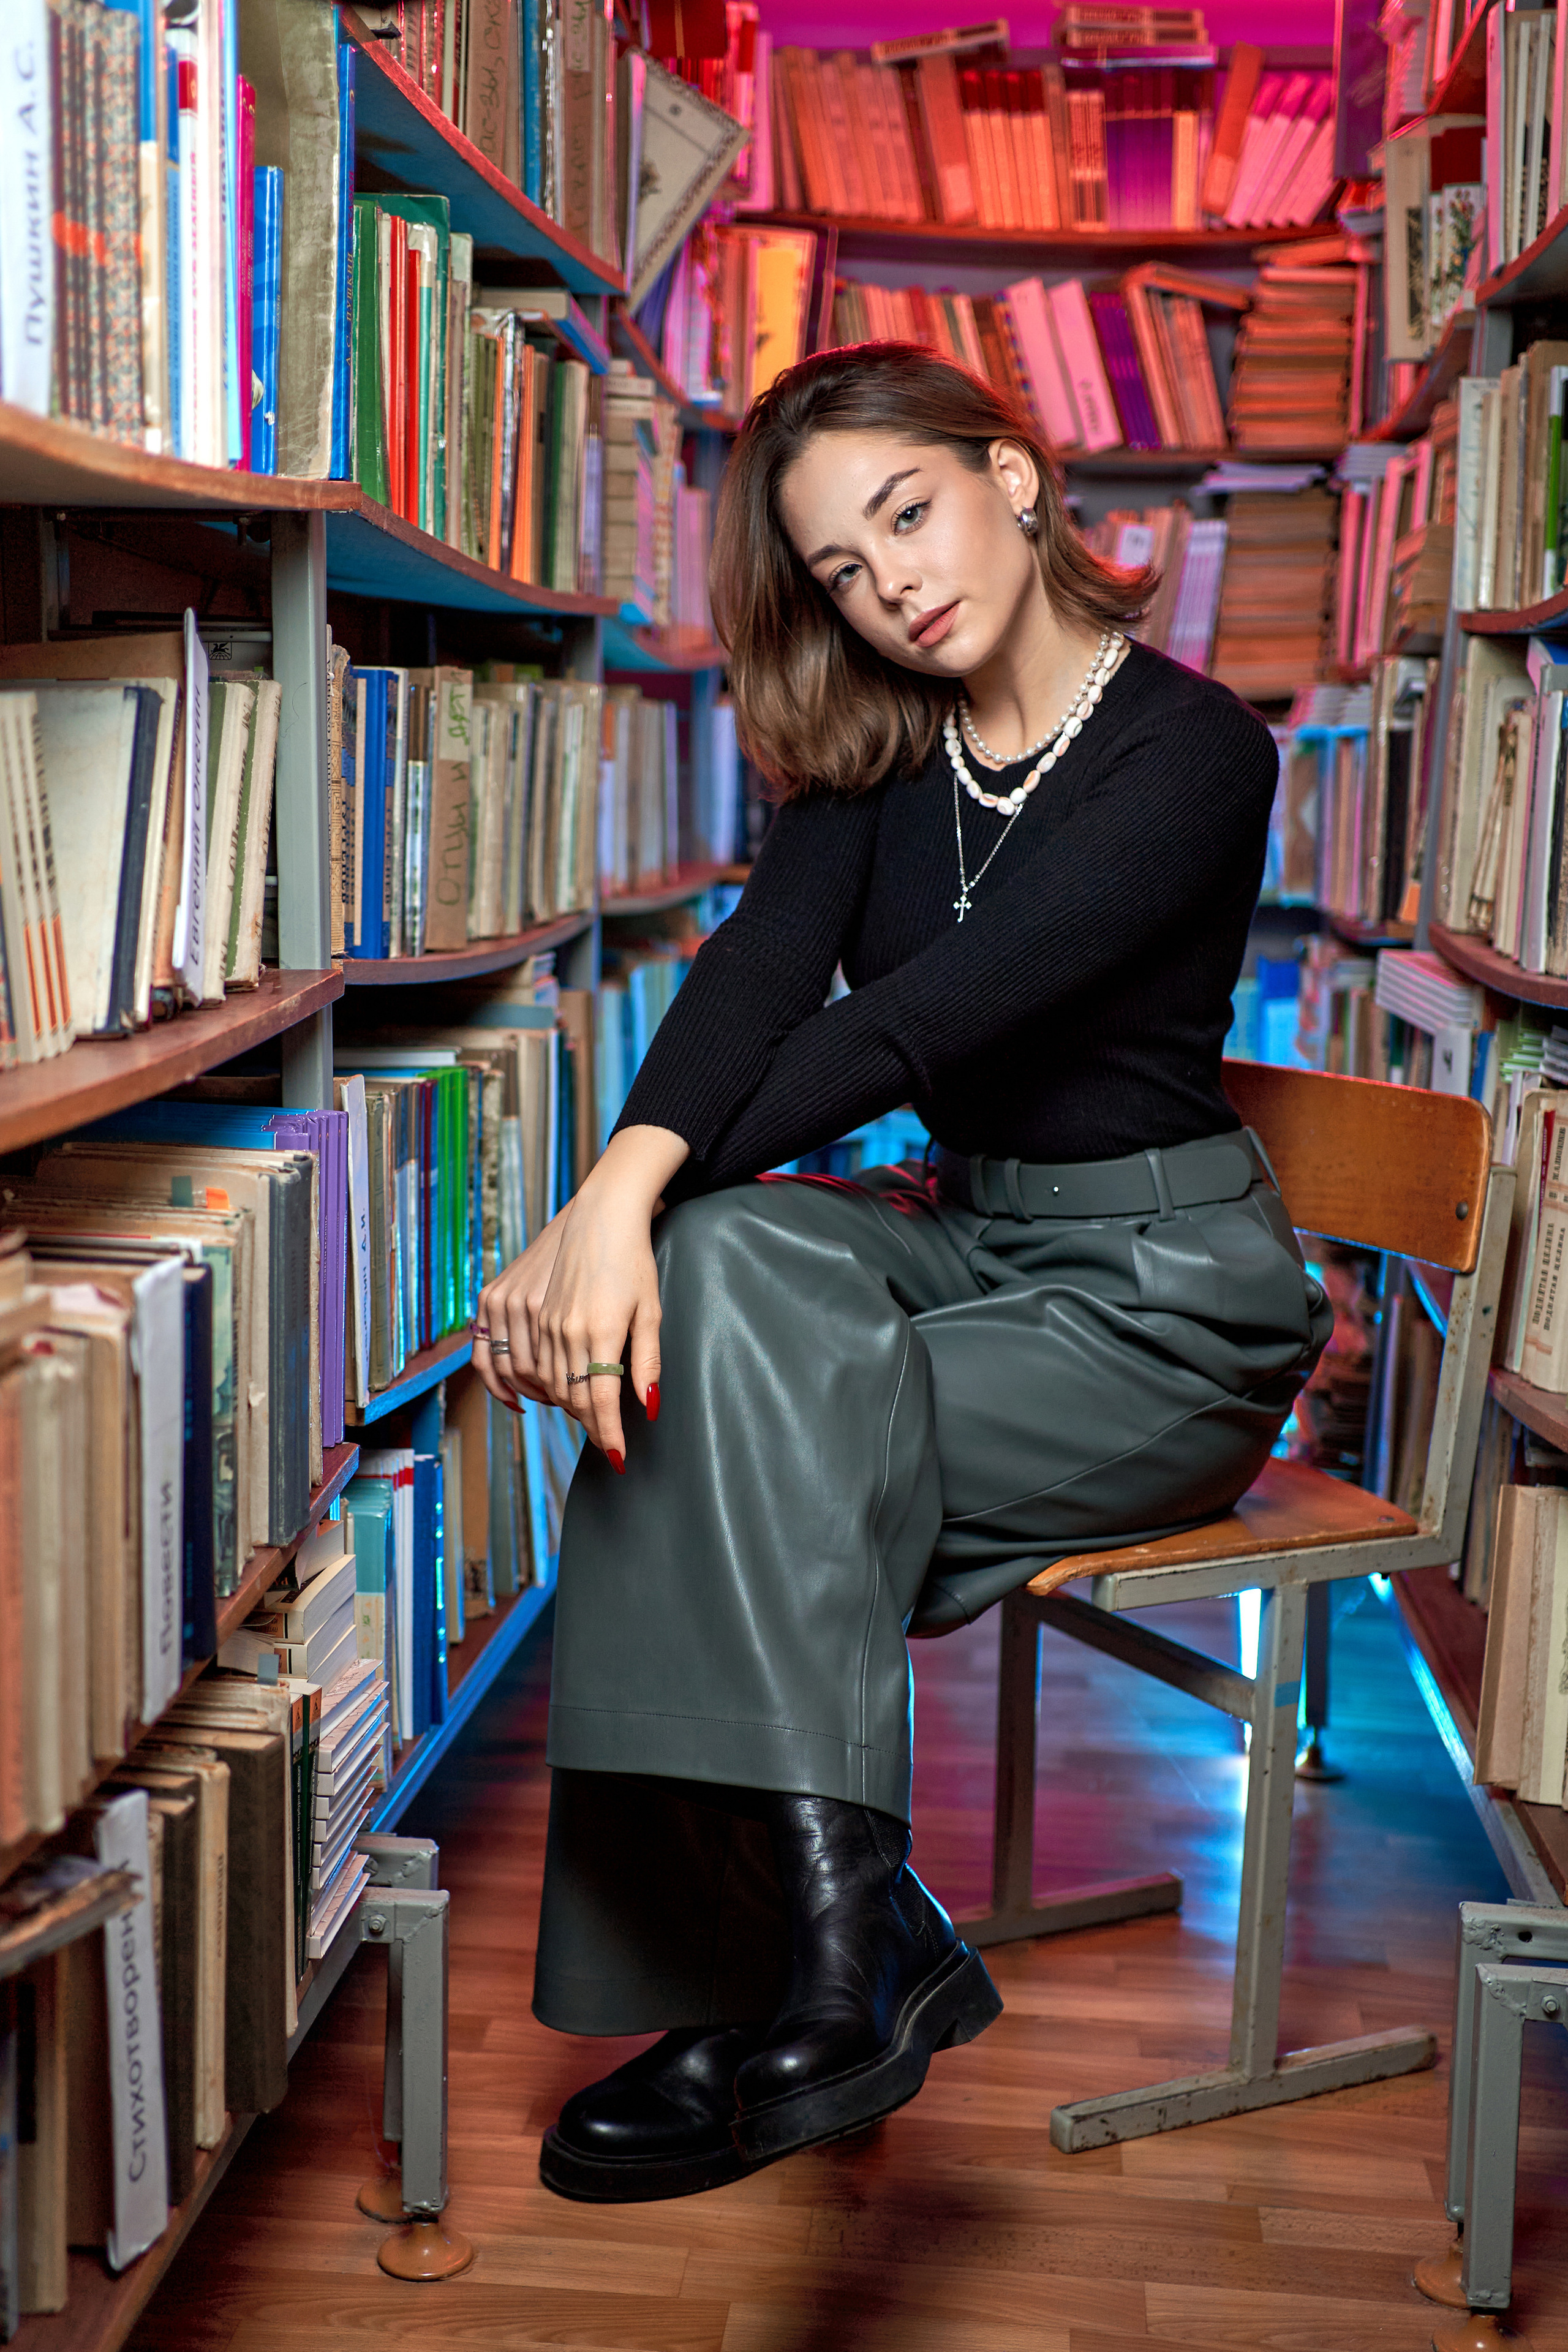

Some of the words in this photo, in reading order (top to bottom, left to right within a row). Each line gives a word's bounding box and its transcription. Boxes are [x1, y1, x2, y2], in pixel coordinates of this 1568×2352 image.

[23, 149, 46, 345] Пушкин
[192, 684, 201, 812] Онегин
[189, 822, 201, 967] Евгений
[434, 801, 469, 907] Отцы
[118, 1860, 147, 2183] Стихотворен
